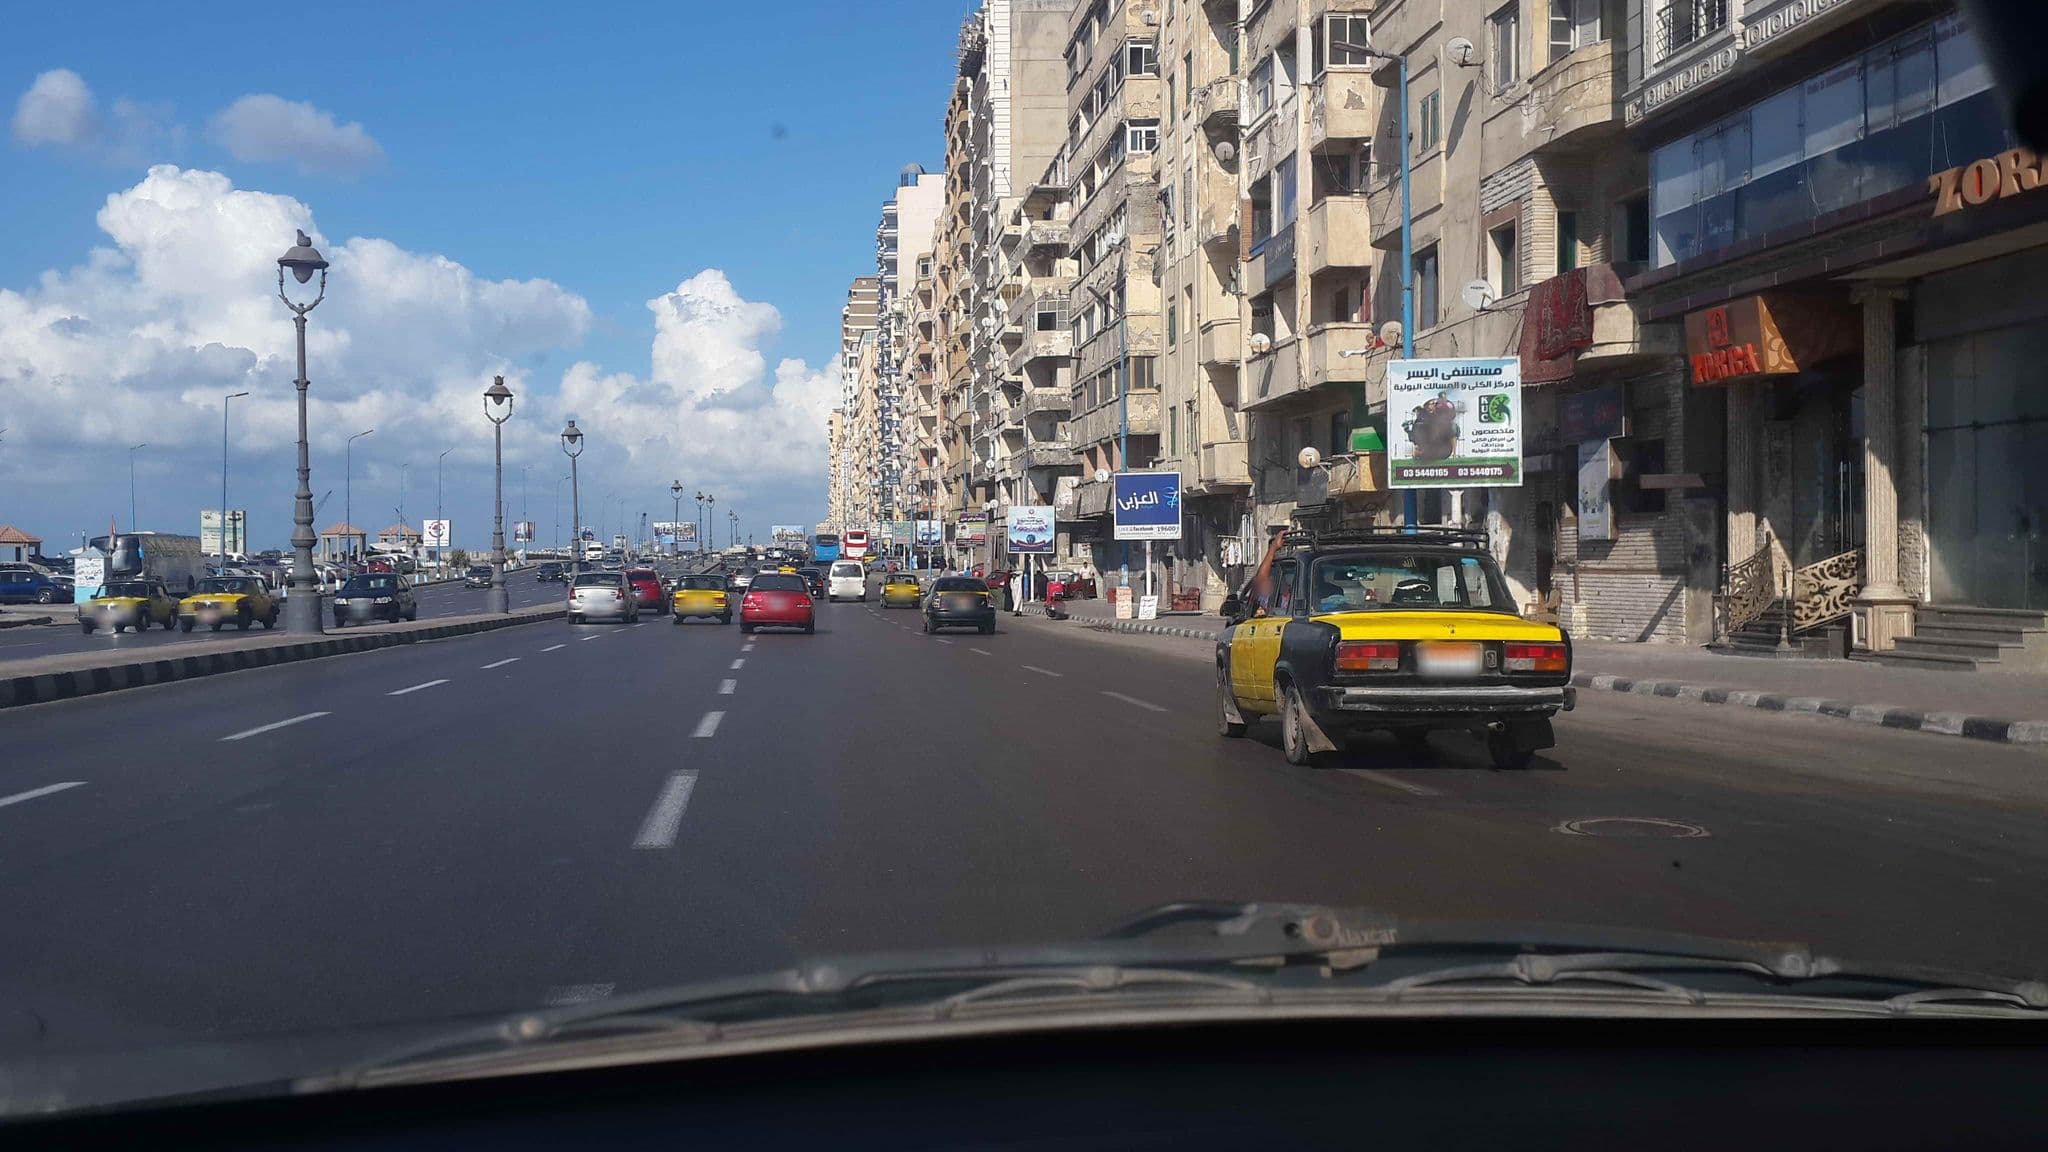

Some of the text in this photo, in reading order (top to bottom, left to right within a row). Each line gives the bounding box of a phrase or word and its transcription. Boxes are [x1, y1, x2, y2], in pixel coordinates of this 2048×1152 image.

[1928, 147, 2048, 217] ZOR
[1406, 366, 1503, 380] مستشفى اليسر
[1393, 383, 1422, 391] البولية
[1424, 382, 1459, 390] المسالك
[1461, 383, 1467, 391] و
[1494, 380, 1515, 389] مركز
[1480, 396, 1489, 421] KUC
[1403, 468, 1414, 477] 03
[1457, 468, 1469, 476] 03
